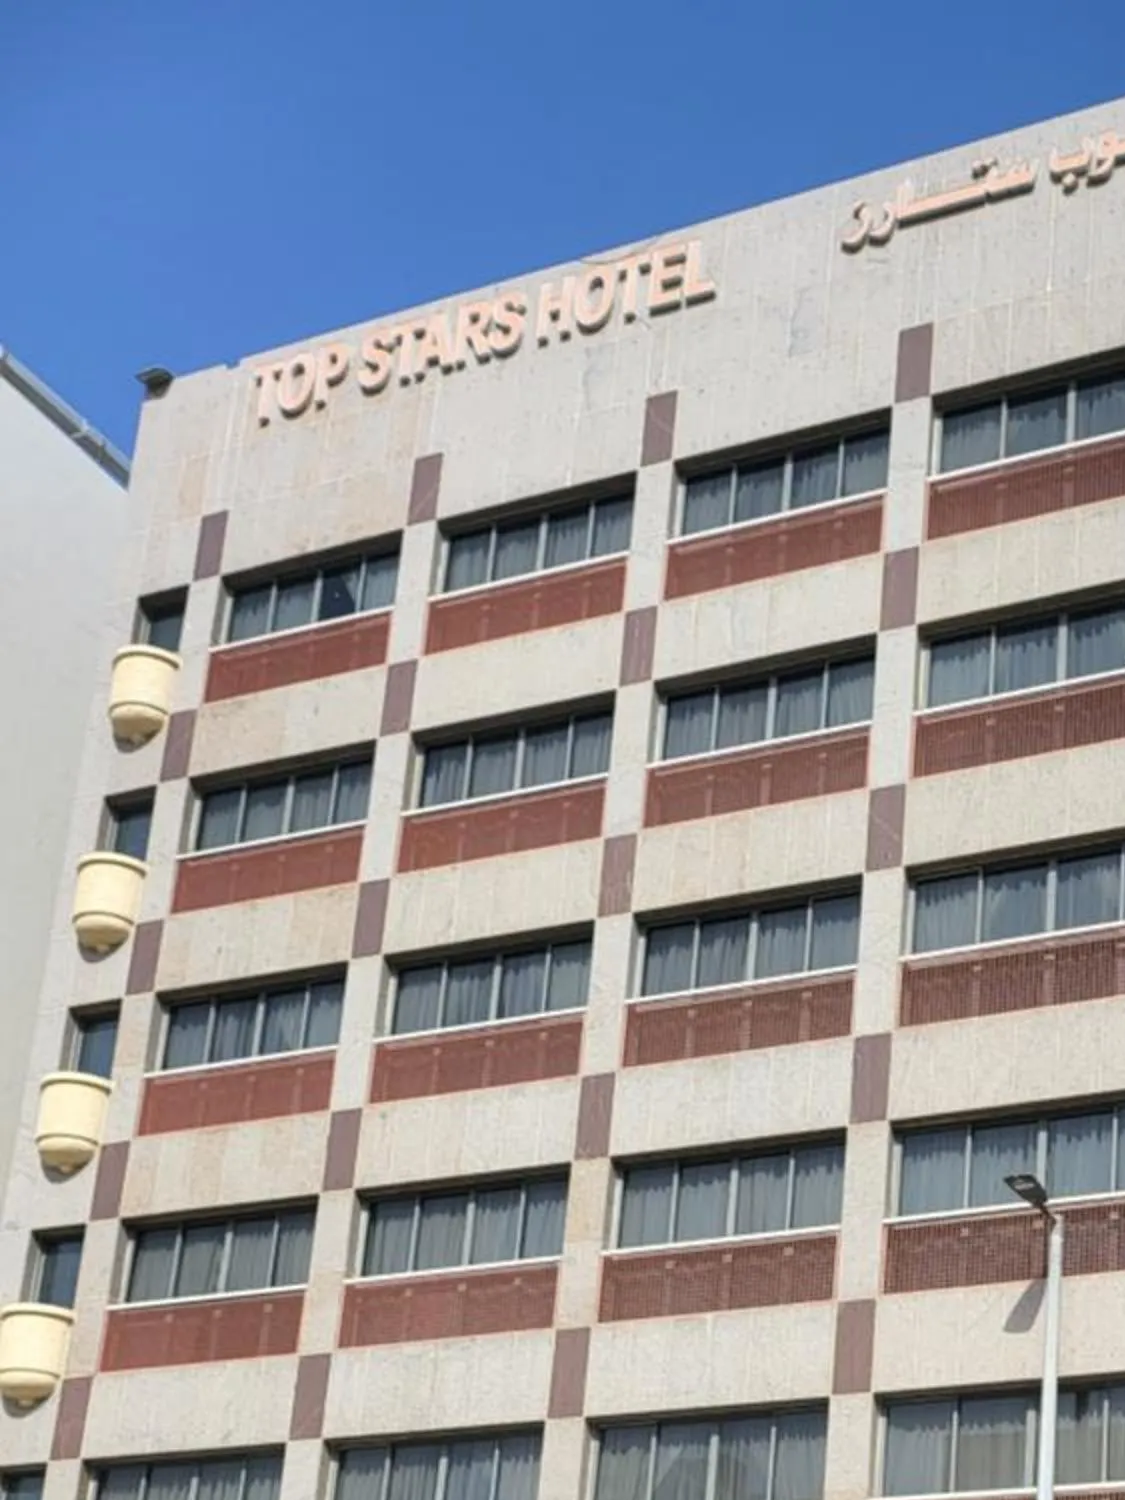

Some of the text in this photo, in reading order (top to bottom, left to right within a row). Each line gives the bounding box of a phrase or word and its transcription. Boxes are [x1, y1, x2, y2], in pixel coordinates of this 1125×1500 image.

[254, 240, 716, 427] TOP STARS HOTEL
